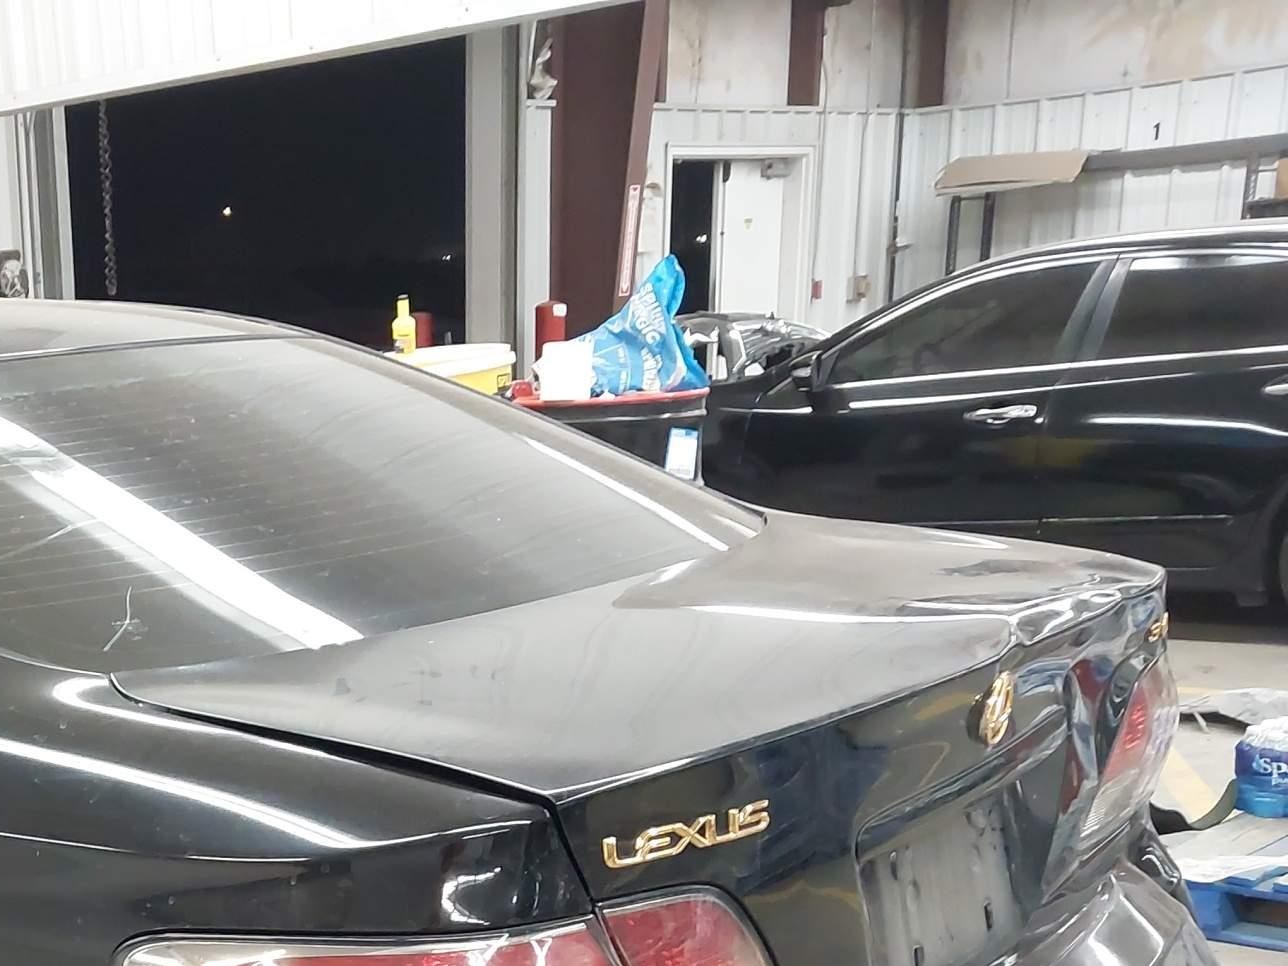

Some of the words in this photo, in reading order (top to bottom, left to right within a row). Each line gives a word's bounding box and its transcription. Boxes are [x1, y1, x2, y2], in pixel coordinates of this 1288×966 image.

[1153, 122, 1161, 141] 1
[1259, 757, 1288, 778] Sp
[602, 799, 771, 869] LEXUS
